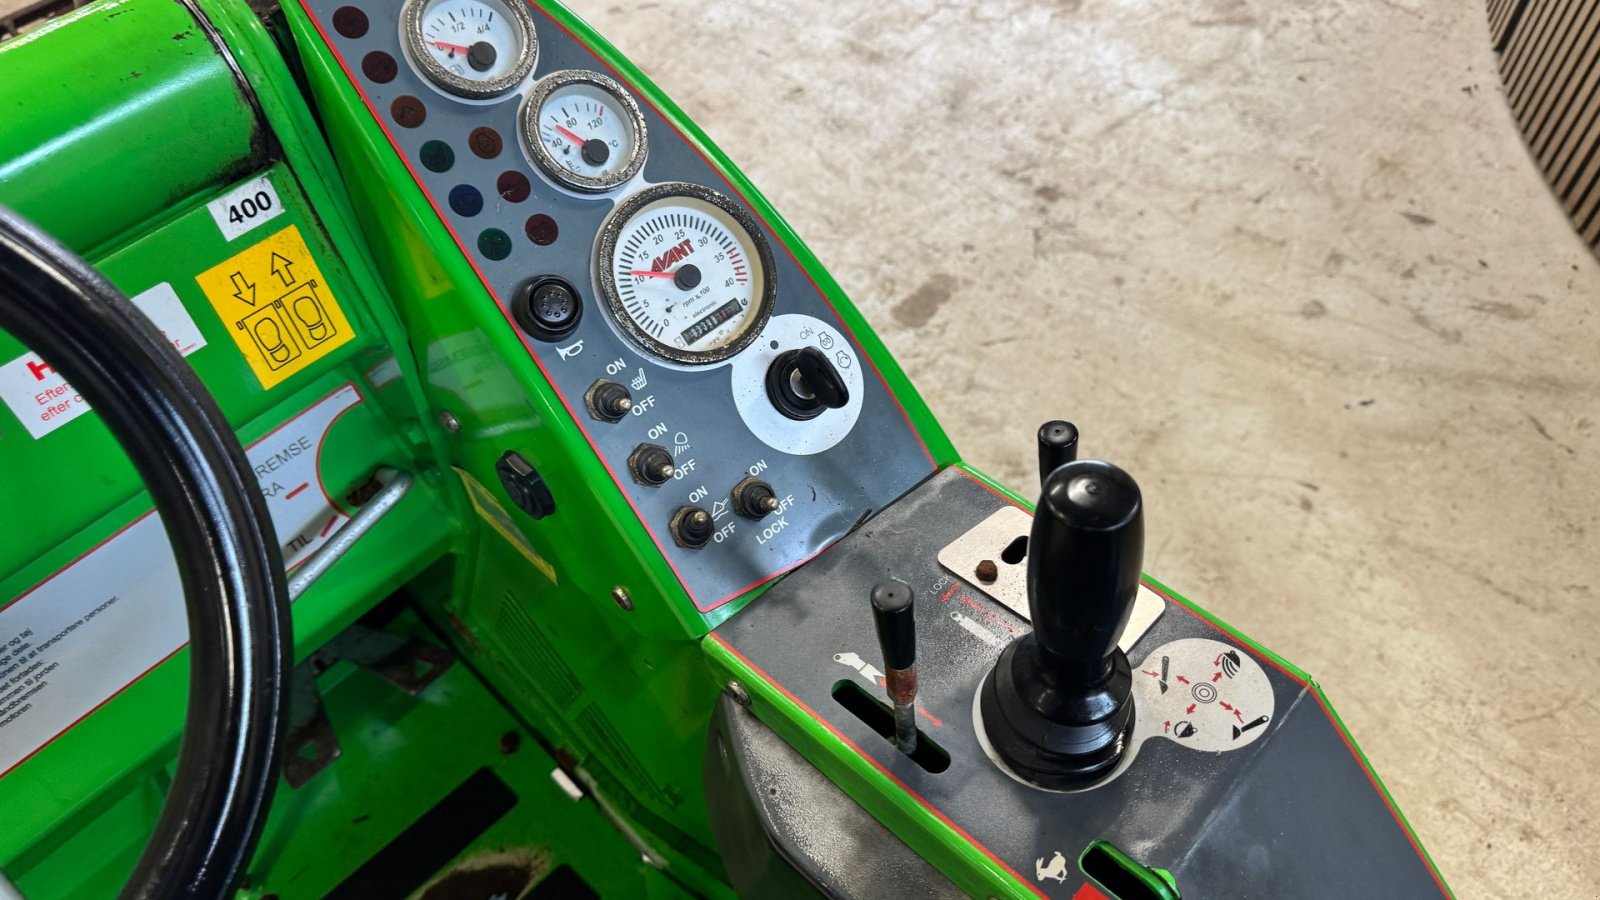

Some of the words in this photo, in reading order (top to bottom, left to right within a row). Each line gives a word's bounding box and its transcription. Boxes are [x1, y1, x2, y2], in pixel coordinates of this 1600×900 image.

[451, 21, 466, 33] 1/2
[476, 24, 491, 35] 4/4
[566, 117, 578, 129] 80
[587, 117, 603, 130] 120
[551, 137, 563, 149] 40
[228, 190, 272, 225] 400
[652, 233, 664, 246] 20
[674, 229, 686, 240] 25
[697, 236, 709, 248] 30
[638, 250, 650, 262] 15
[650, 238, 696, 279] AVANT
[713, 252, 725, 264] 35
[634, 274, 646, 286] 10
[724, 277, 735, 289] 40
[643, 300, 650, 308] 5
[663, 318, 670, 328] 0
[800, 326, 814, 340] ON
[606, 357, 627, 376] ON
[35, 382, 71, 406] Efter
[40, 399, 71, 421] efter
[631, 395, 656, 417] OFF
[647, 422, 668, 440] ON
[254, 435, 313, 479] REMSE
[673, 458, 697, 481] OFF
[749, 459, 769, 477] ON
[688, 485, 709, 503] ON
[713, 521, 737, 544] OFF
[755, 516, 790, 545] LOCK
[286, 533, 314, 553] TIL
